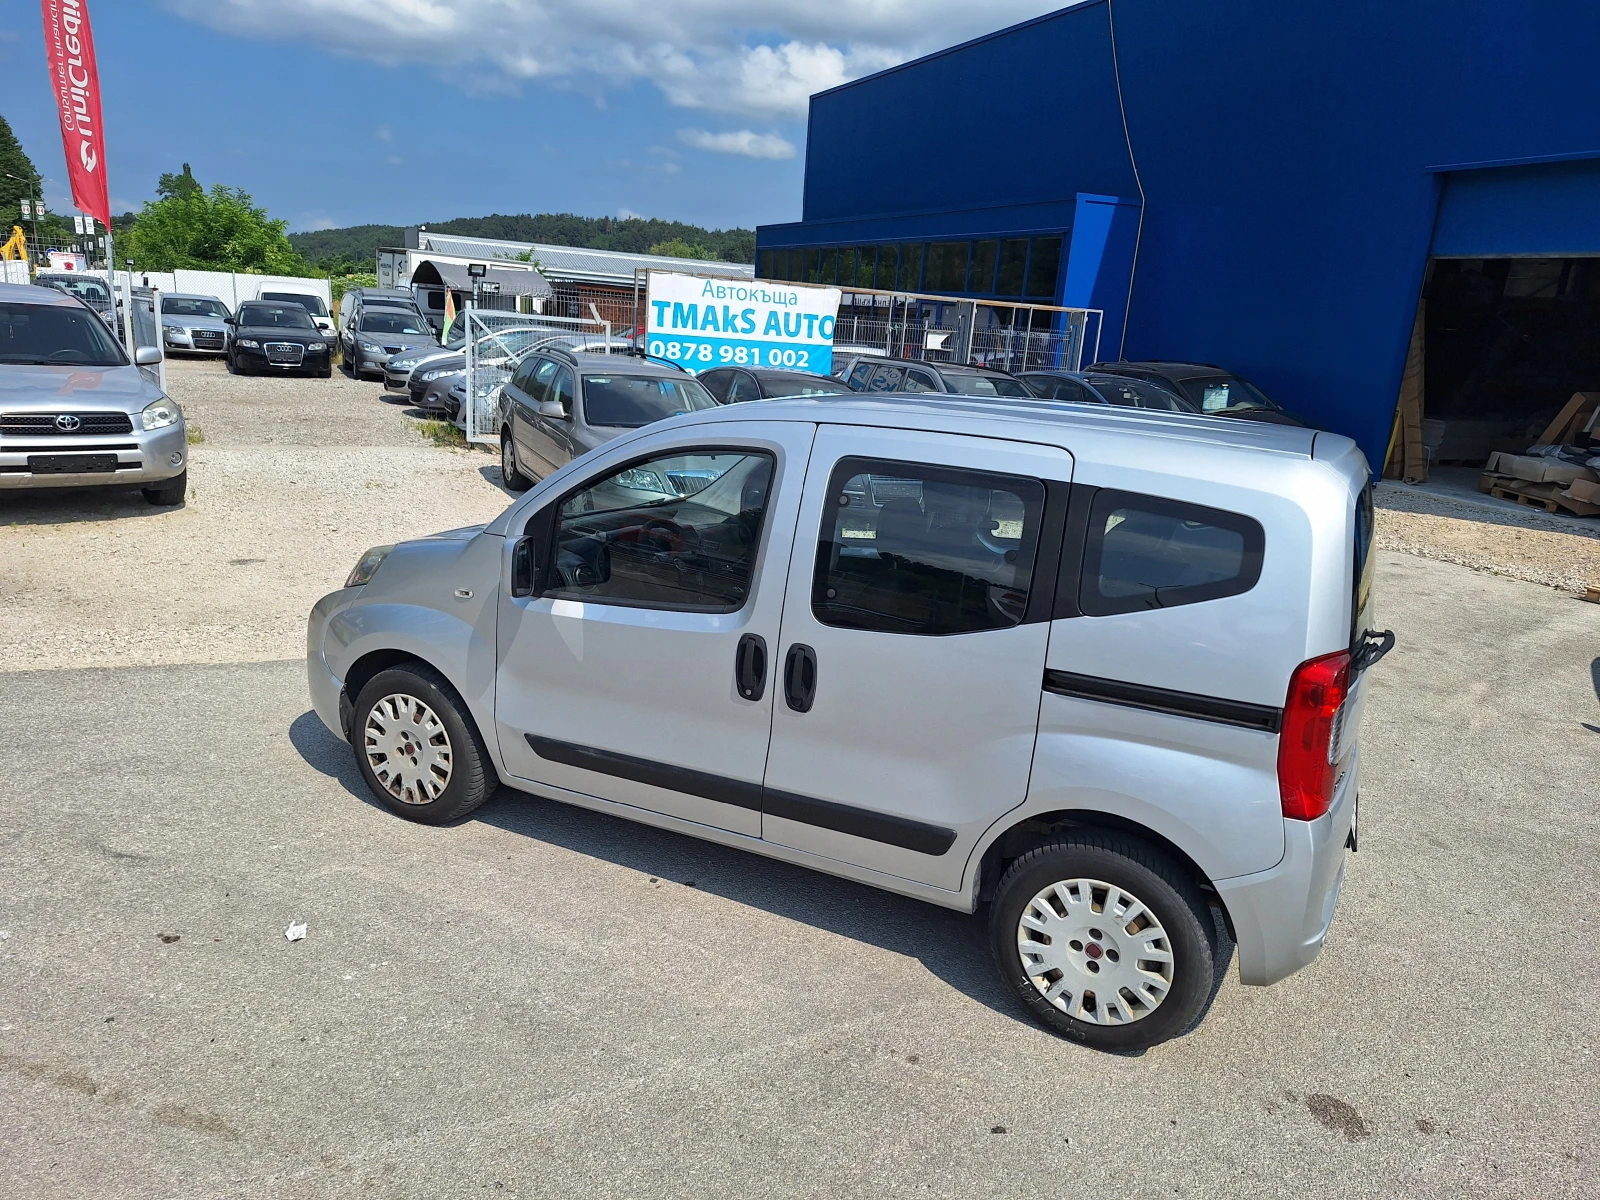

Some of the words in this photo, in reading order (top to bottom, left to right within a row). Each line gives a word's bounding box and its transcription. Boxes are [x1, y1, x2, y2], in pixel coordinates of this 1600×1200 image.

[702, 280, 798, 308] Автокъща
[652, 300, 756, 334] TMAkS
[763, 311, 835, 340] AUTO
[649, 340, 713, 361] 0878
[719, 345, 760, 365] 981
[768, 348, 809, 367] 002
